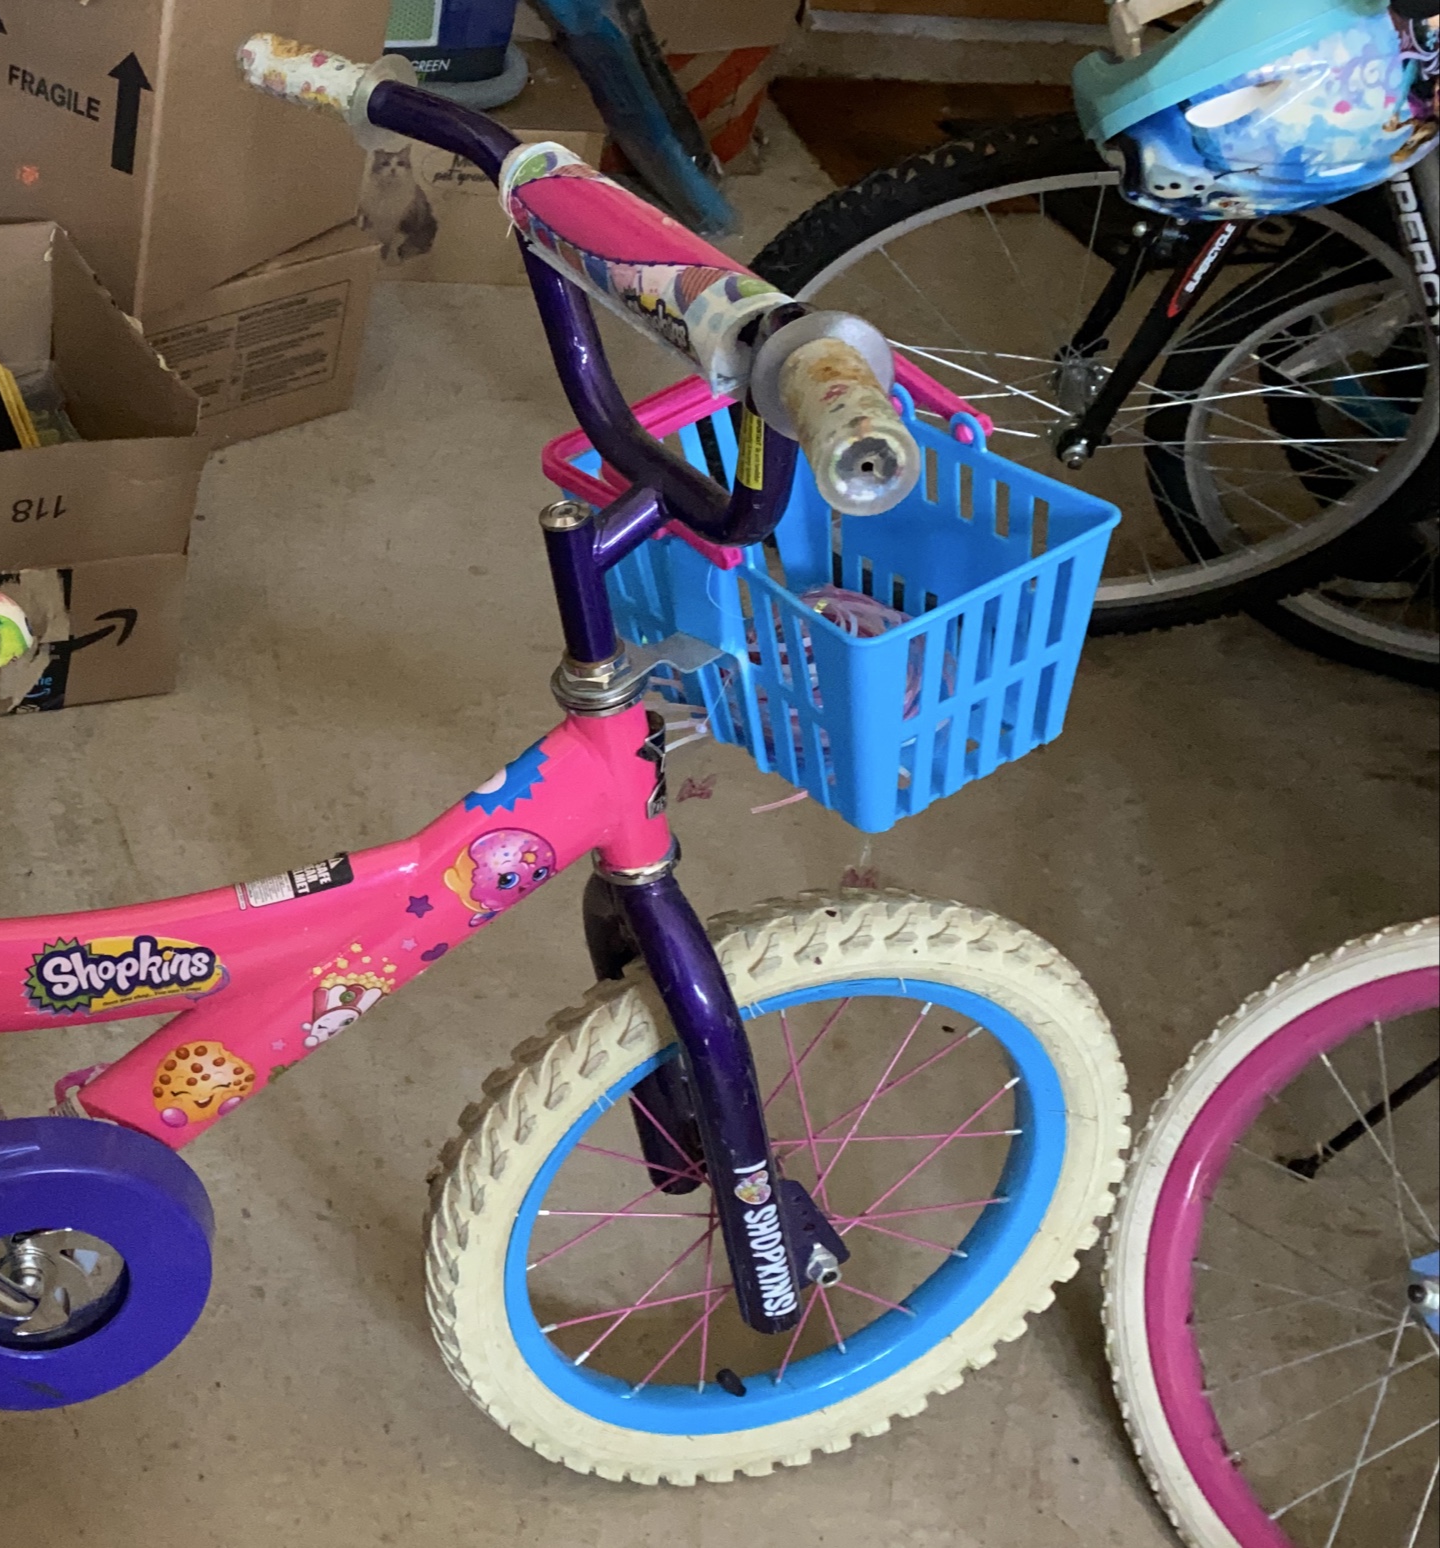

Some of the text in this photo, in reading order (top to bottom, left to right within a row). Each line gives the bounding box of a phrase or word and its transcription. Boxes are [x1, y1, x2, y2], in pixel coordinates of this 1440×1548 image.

[8, 64, 101, 122] FRAGILE
[1183, 222, 1237, 293] SUPERCYCLE
[11, 494, 66, 523] 118
[43, 941, 210, 996] Shopkins
[734, 1160, 799, 1318] I SHOPKINS!
